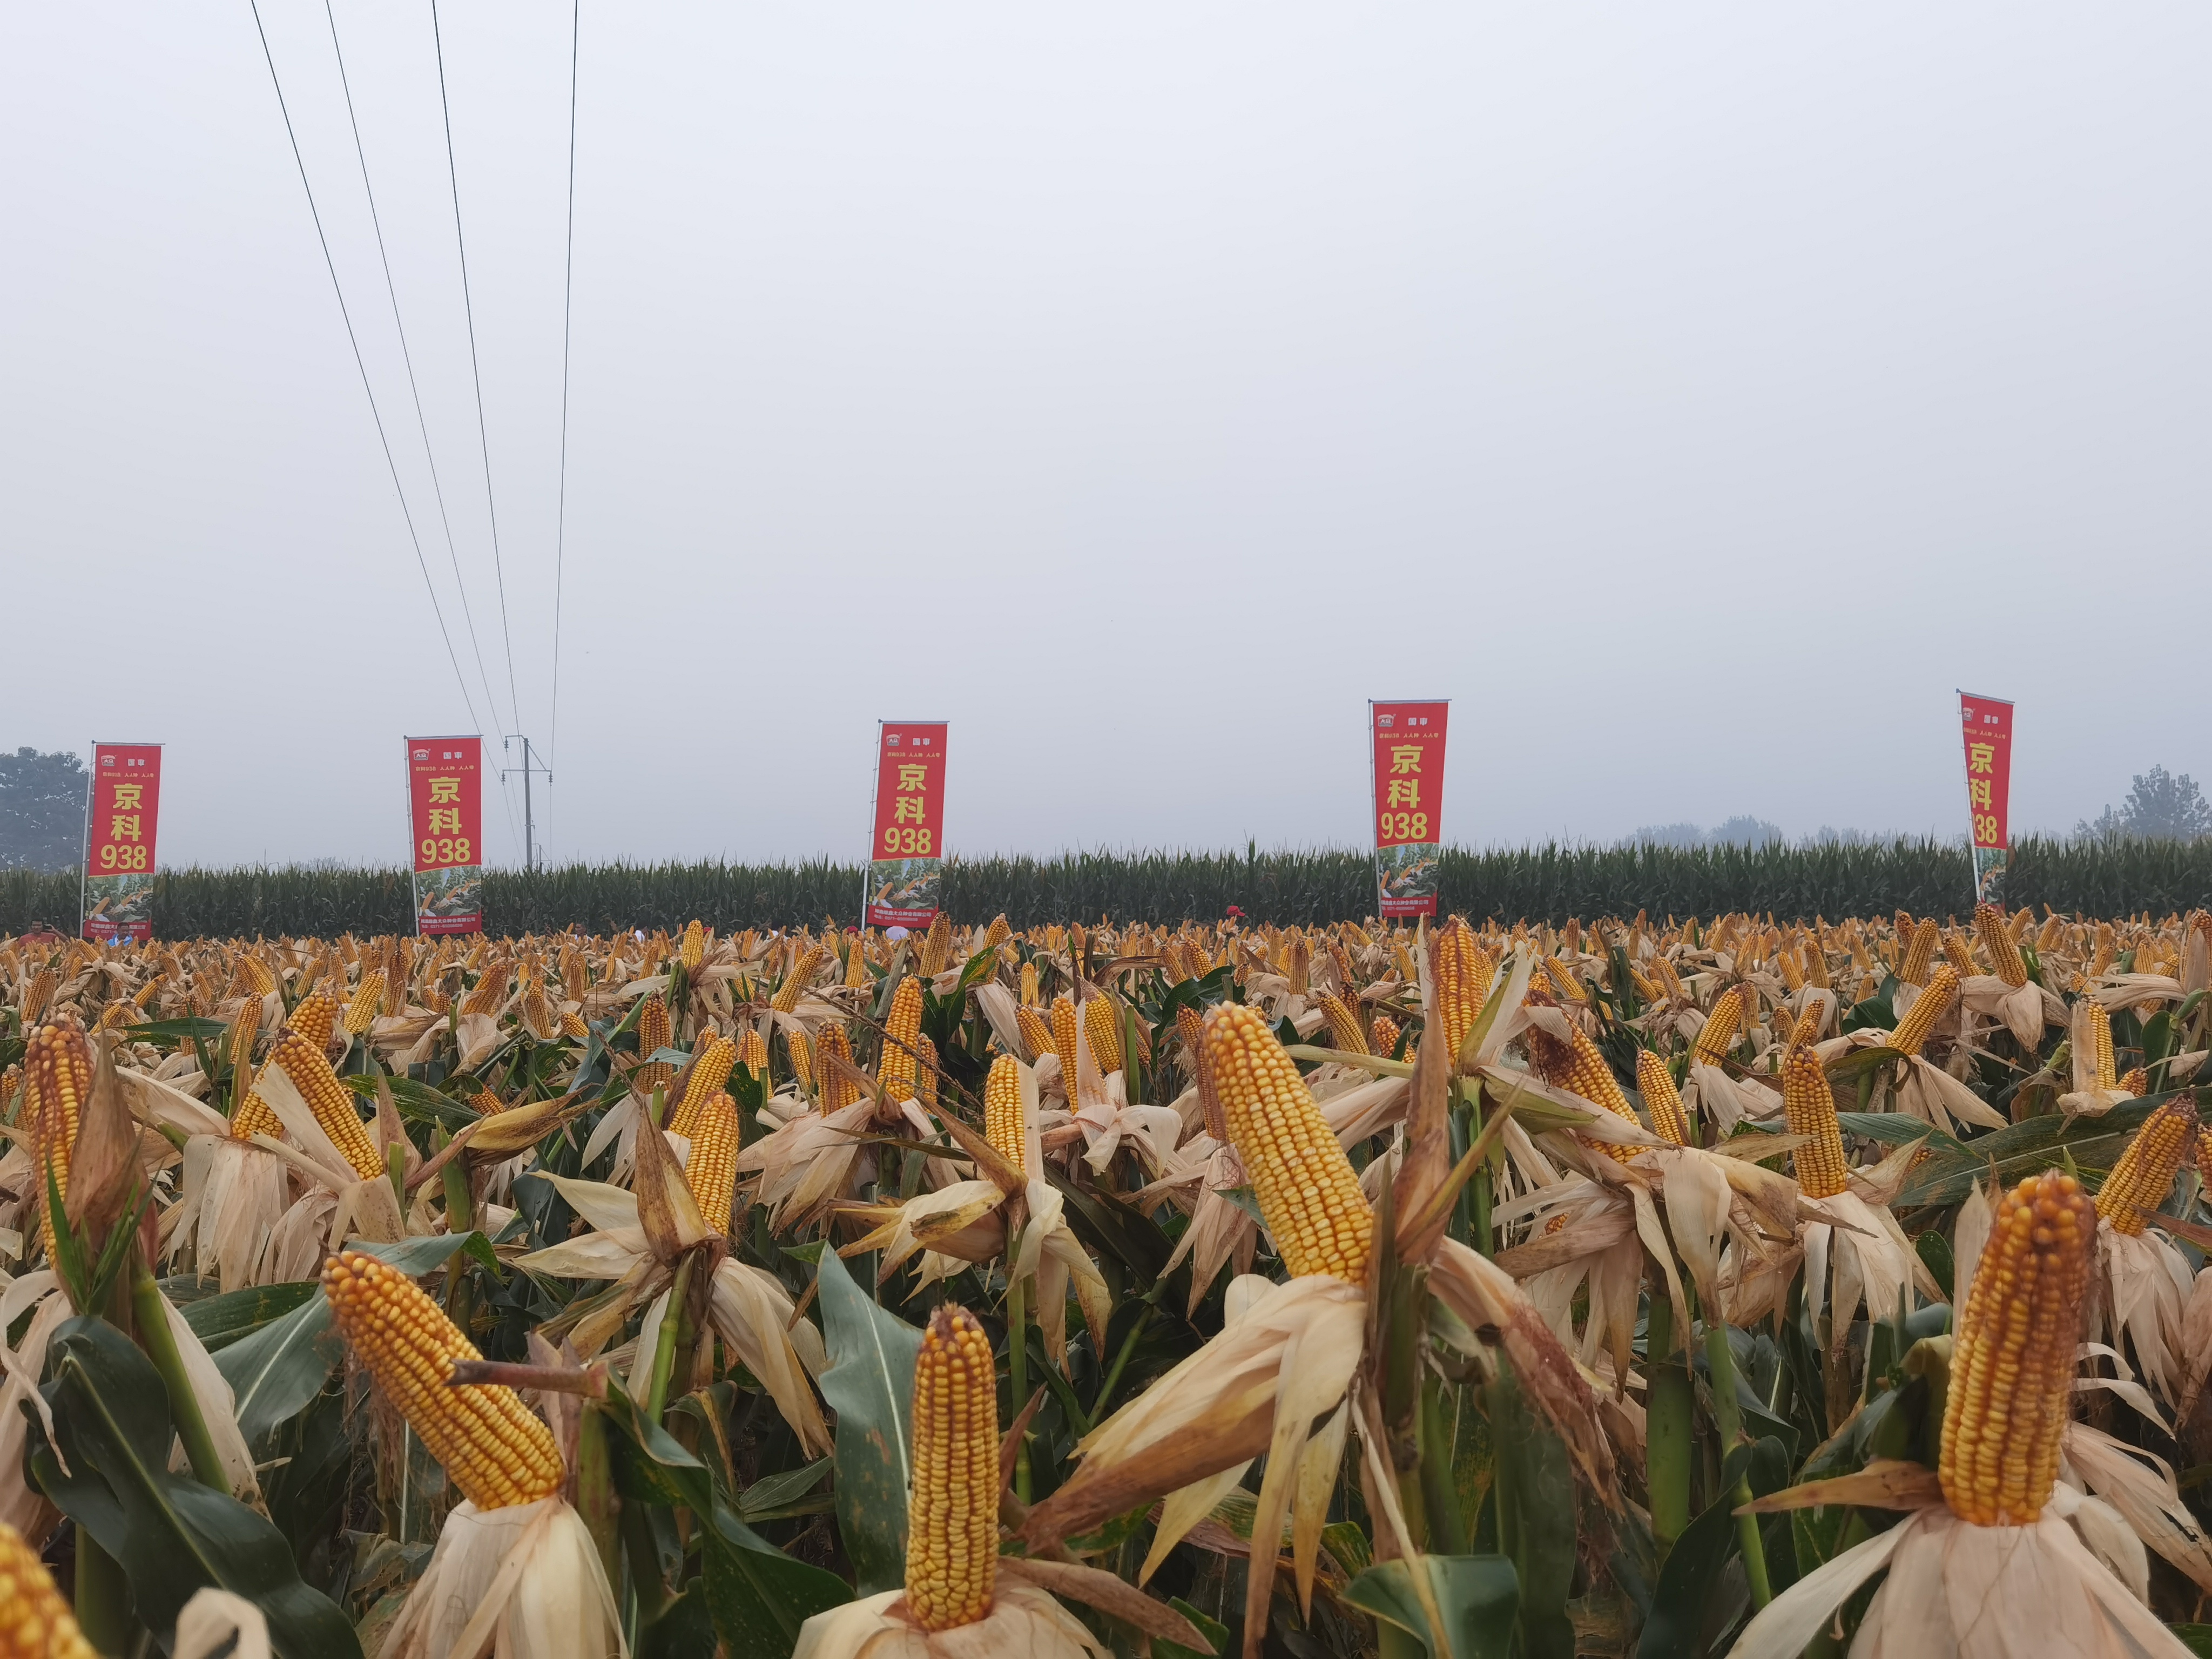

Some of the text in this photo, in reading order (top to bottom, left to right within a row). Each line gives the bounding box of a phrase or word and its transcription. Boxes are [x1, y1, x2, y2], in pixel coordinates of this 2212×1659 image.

[894, 764, 928, 825] 京科
[1387, 744, 1424, 809] 京科
[1970, 742, 1995, 811] 京科
[112, 784, 142, 841] 京科
[428, 777, 462, 835] 京科
[1381, 812, 1427, 839] 938
[1972, 812, 1998, 844] 38
[100, 845, 147, 869] 938
[421, 838, 470, 864] 938
[884, 827, 932, 854] 938
